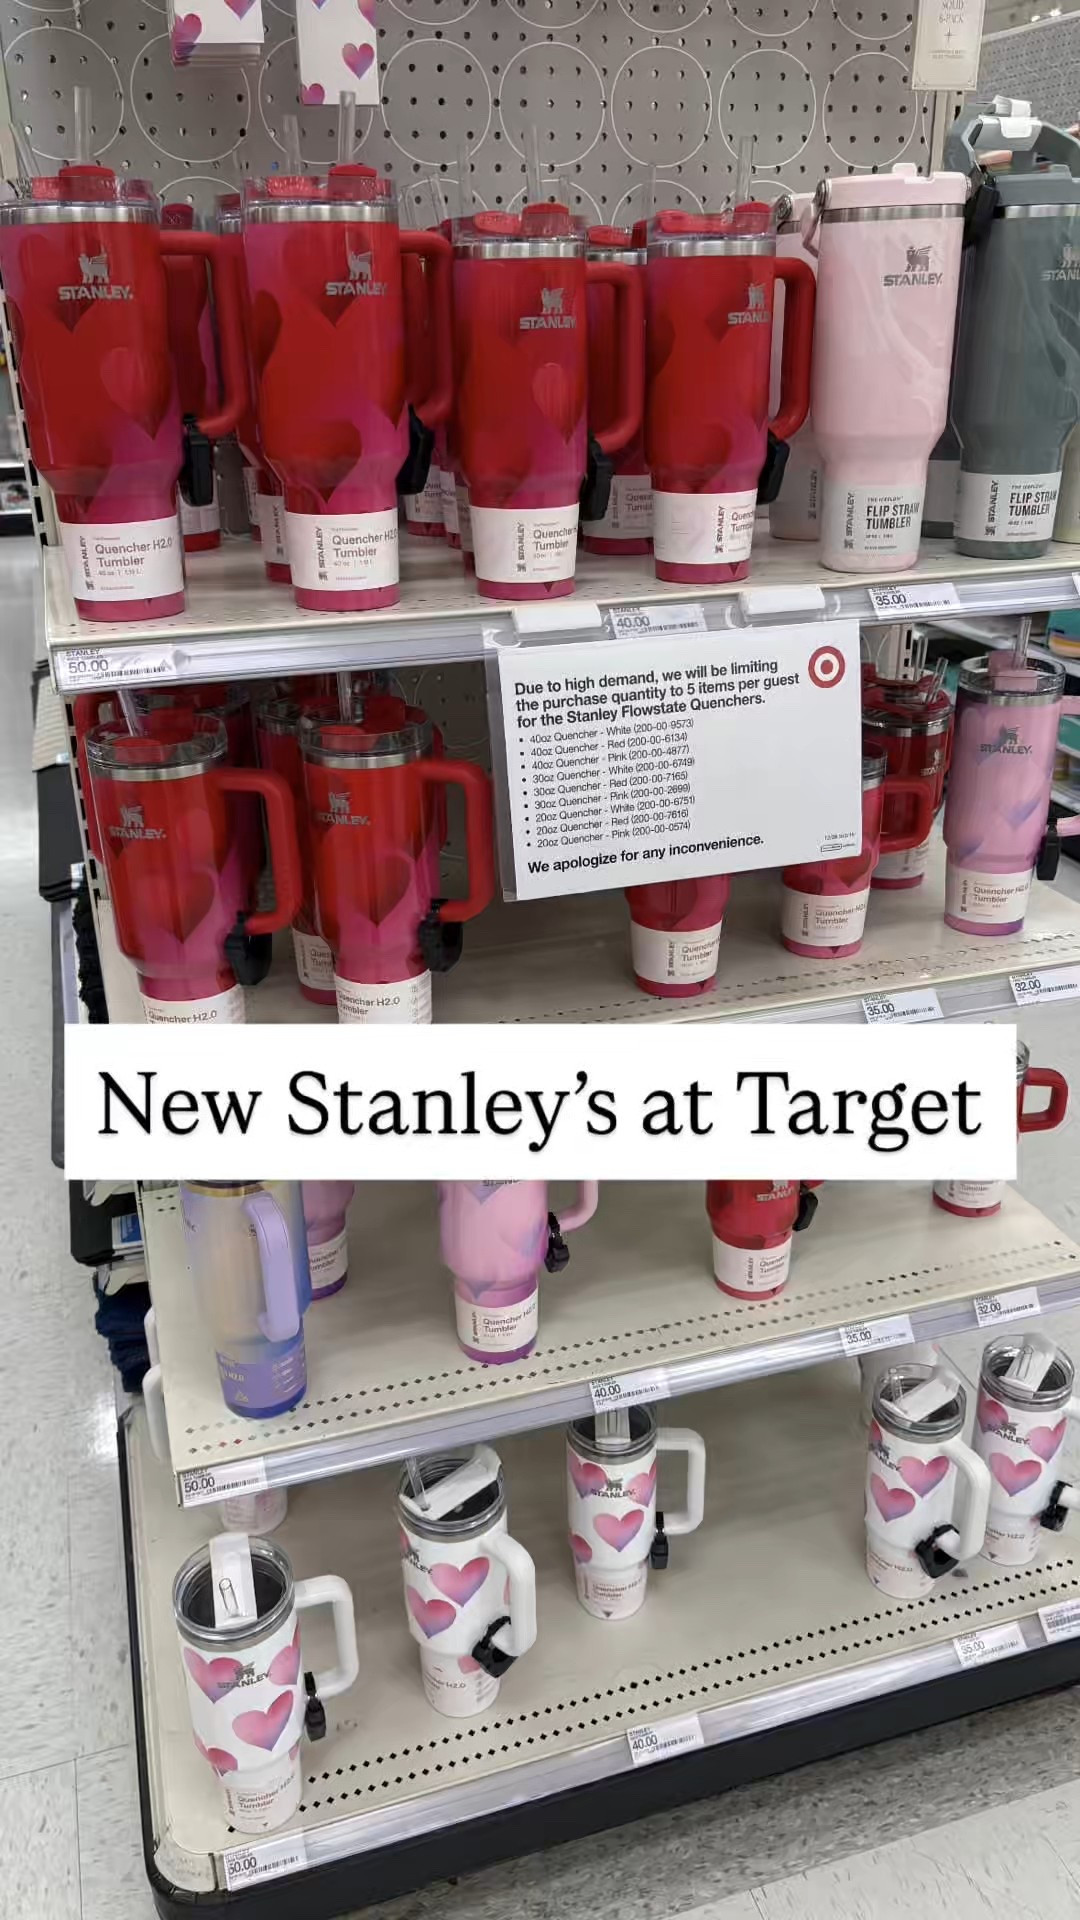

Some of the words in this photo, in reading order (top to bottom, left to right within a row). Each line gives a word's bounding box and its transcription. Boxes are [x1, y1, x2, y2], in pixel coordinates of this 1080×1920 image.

[883, 272, 943, 287] STANLEY
[1040, 269, 1080, 281] STANL
[59, 285, 133, 300] STANLEY
[1010, 492, 1032, 503] FLIP
[866, 505, 889, 517] FLIP
[892, 502, 920, 516] STRAW
[716, 505, 726, 545] STANLEY
[866, 516, 911, 529] TUMBLER
[332, 533, 383, 546] Quencher
[95, 541, 151, 555] Quencher
[334, 547, 377, 558] Tumbler
[96, 556, 145, 568] Tumbler
[876, 594, 907, 606] 35.00
[617, 616, 650, 628] 40.00
[69, 659, 109, 674] 50.00
[514, 682, 543, 695] Due
[547, 680, 561, 692] to
[565, 677, 595, 692] high
[599, 670, 659, 688] demand,
[662, 671, 682, 681] we
[685, 665, 707, 680] will
[711, 664, 727, 676] be
[731, 660, 778, 675] limiting
[516, 699, 539, 711] the
[543, 694, 608, 712] purchase
[611, 686, 666, 704] quantity
[670, 685, 683, 697] to
[687, 683, 695, 695] 5
[699, 681, 735, 694] items
[739, 678, 760, 693] per
[763, 673, 800, 690] guest
[517, 715, 537, 728] for
[540, 713, 563, 726] the
[567, 708, 618, 723] Stanley
[621, 701, 687, 718] Flowstate
[690, 694, 765, 711] Quenchers.
[530, 734, 551, 743] 40oz
[554, 730, 598, 742] Quencher
[606, 726, 631, 736] White
[531, 747, 553, 756] 40oz
[555, 743, 599, 755] Quencher
[607, 740, 625, 749] Red
[532, 760, 554, 769] 40oz
[556, 756, 599, 768] Quencher
[608, 753, 627, 762] Pink
[533, 774, 554, 782] 30oz
[556, 769, 600, 781] Quencher
[609, 765, 634, 775] White
[533, 787, 555, 796] 30oz
[557, 782, 601, 794] Quencher
[609, 779, 627, 788] Red
[534, 800, 556, 809] 30oz
[558, 795, 602, 807] Quencher
[610, 791, 629, 801] Pink
[535, 814, 557, 822] 20oz
[559, 808, 602, 820] Quencher
[611, 804, 635, 814] White
[536, 827, 558, 835] 20oz
[560, 821, 602, 833] Quencher
[611, 817, 629, 826] Red
[537, 839, 559, 848] 20oz
[561, 833, 603, 846] Quencher
[612, 829, 630, 839] Pink
[527, 861, 550, 874] We
[553, 854, 617, 872] apologize
[621, 850, 639, 862] for
[642, 847, 665, 860] any
[669, 834, 764, 856] inconvenience.
[1015, 979, 1041, 992] 32.00
[376, 997, 400, 1007] H2.0
[867, 1003, 895, 1016] 35.00
[193, 1009, 217, 1022] H2.0
[978, 1302, 1001, 1315] 32.00
[483, 1313, 522, 1326] Quencher
[483, 1323, 517, 1333] Tumbler
[846, 1330, 871, 1344] 35.00
[594, 1384, 621, 1398] 40.00
[185, 1476, 215, 1493] 50.00
[632, 1734, 658, 1750] 40.00
[229, 1856, 257, 1876] 50.00
